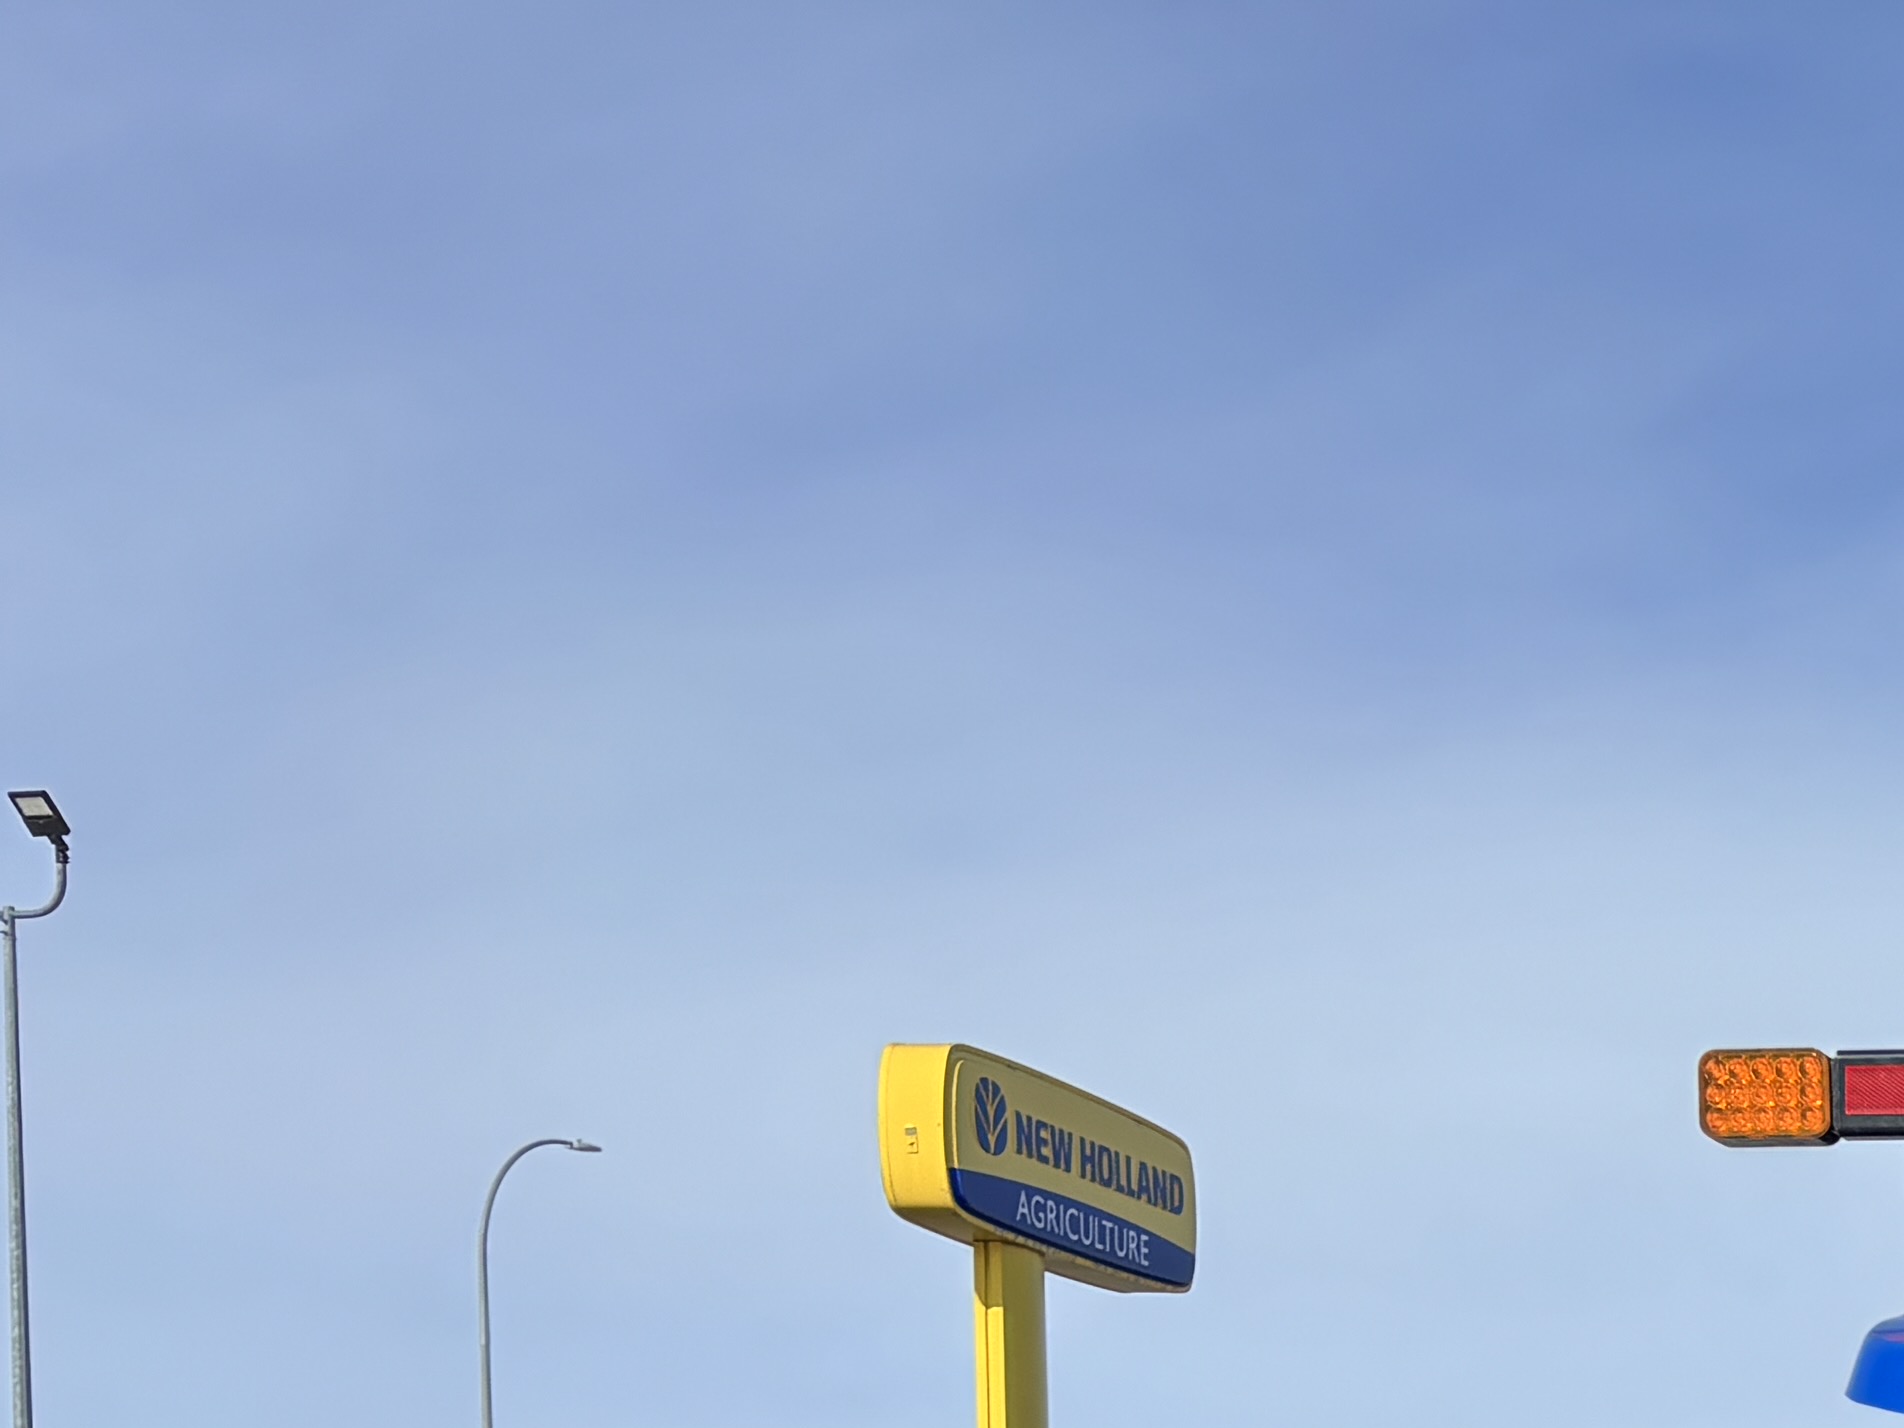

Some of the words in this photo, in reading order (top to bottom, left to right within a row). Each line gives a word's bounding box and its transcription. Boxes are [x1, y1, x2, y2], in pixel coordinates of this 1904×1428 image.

[1015, 1109, 1073, 1173] NEW
[1079, 1136, 1184, 1216] HOLLAND
[1015, 1190, 1149, 1266] AGRICULTURE
